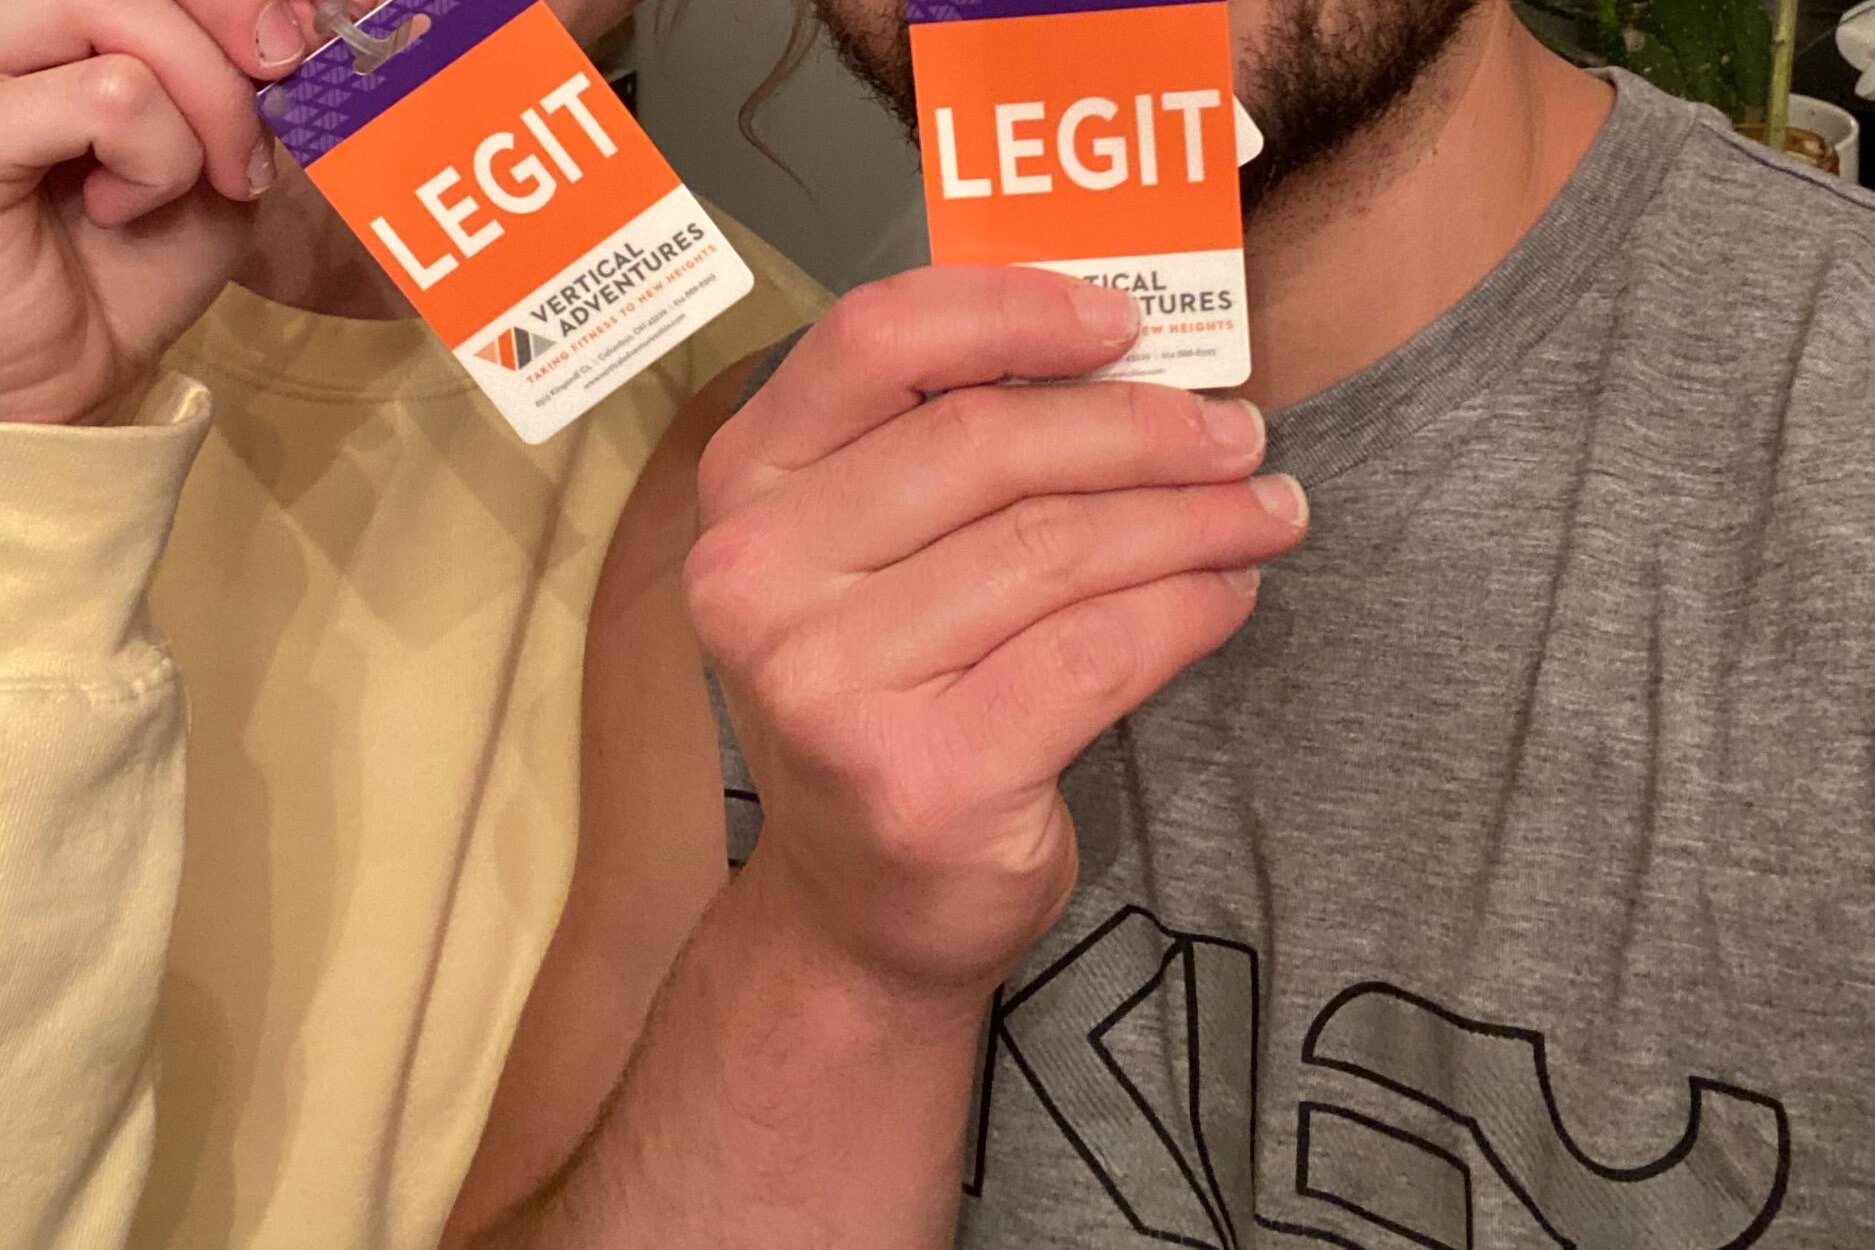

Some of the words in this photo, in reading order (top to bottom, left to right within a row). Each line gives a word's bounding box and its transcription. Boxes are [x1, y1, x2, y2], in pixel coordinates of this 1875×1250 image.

[370, 72, 619, 292] LEGIT
[935, 89, 1222, 201] LEGIT
[526, 349, 570, 386] TAKING
[570, 314, 619, 353] FITNESS
[619, 301, 636, 317] TO
[636, 280, 665, 304] NEW
[664, 241, 717, 284] HEIGHTS
[530, 240, 645, 325] VERTICAL
[556, 223, 705, 337] ADVENTURES
[1083, 271, 1166, 291] TICAL
[1134, 290, 1233, 316] TURES
[1170, 320, 1234, 334] HEIGHTS
